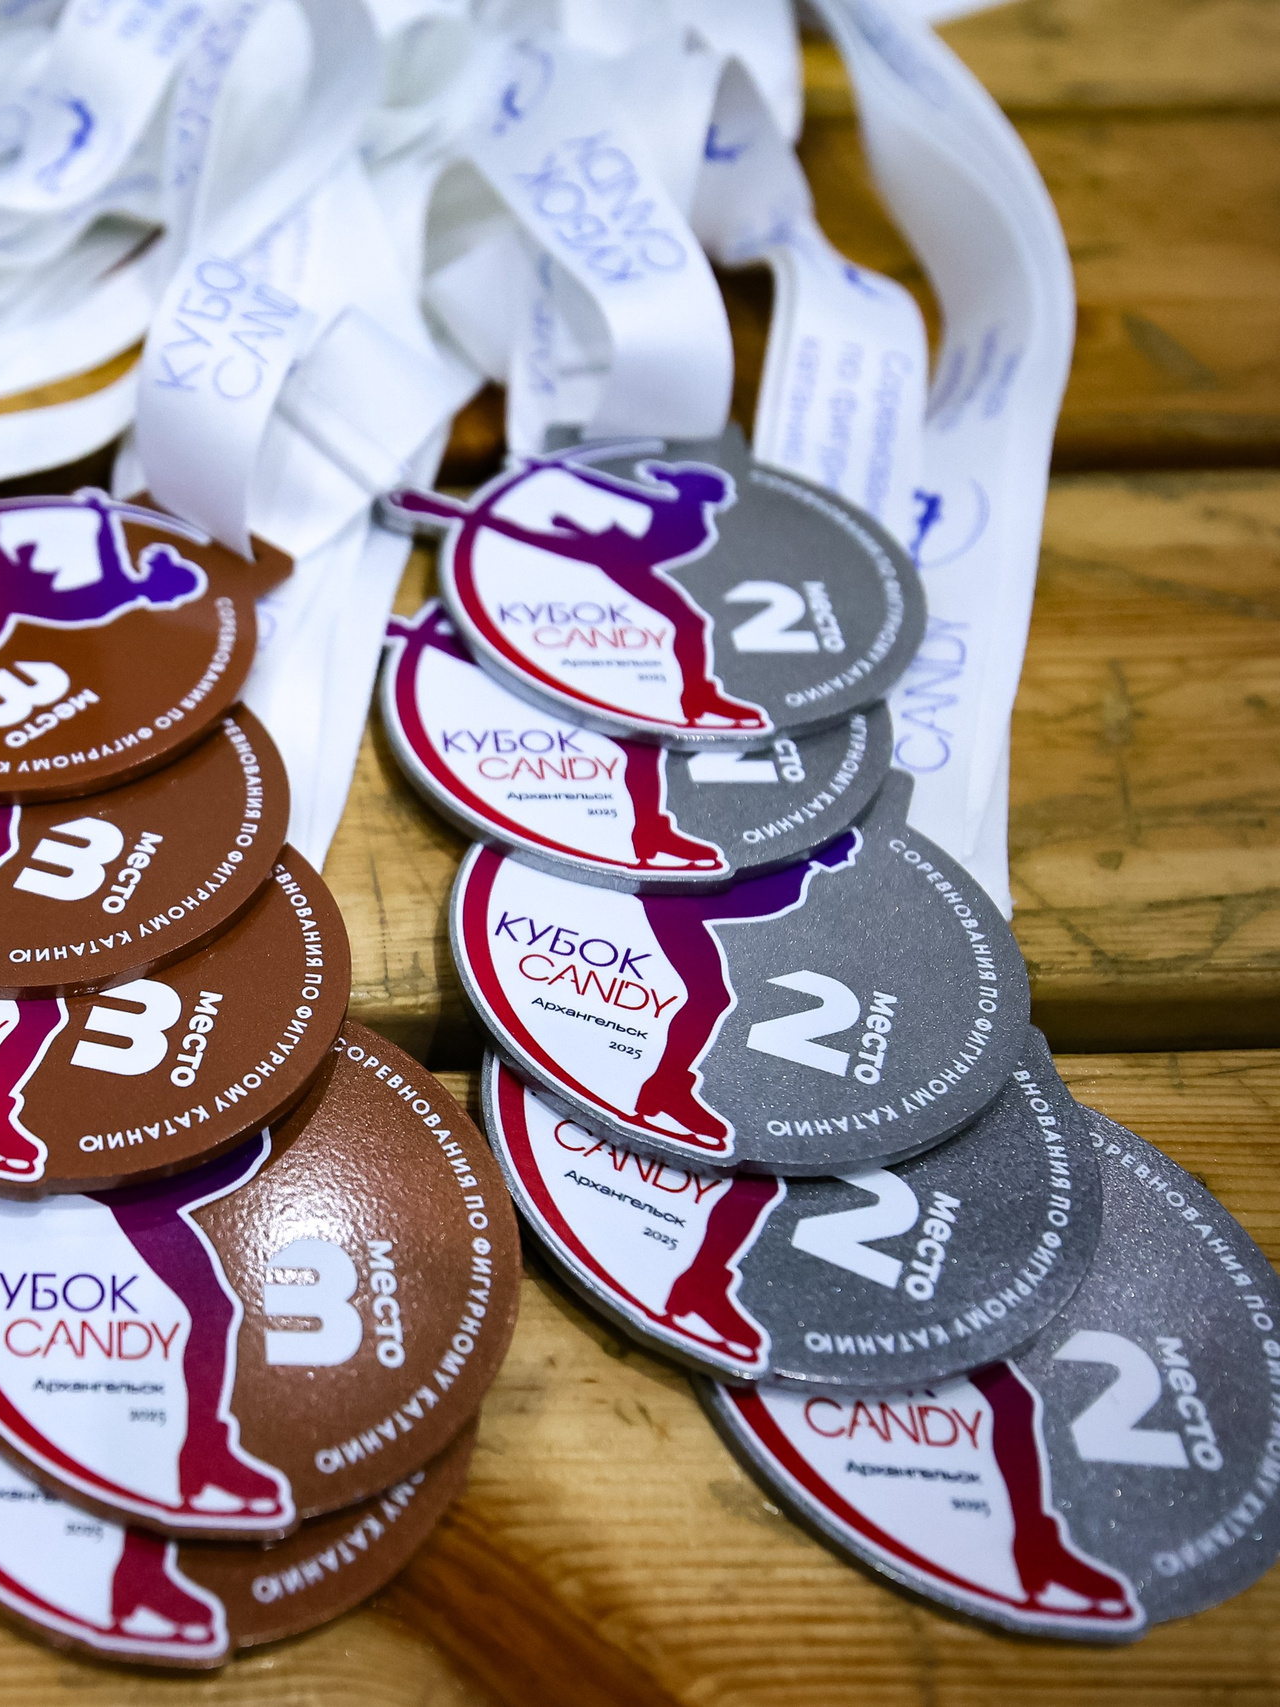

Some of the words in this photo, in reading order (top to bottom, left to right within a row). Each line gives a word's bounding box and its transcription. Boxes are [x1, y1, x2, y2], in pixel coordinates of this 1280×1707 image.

[153, 258, 247, 394] КУБО
[497, 601, 632, 626] КУБОК
[534, 626, 667, 651] CANDY
[724, 579, 820, 654] 2
[4, 688, 101, 748] Место
[18, 725, 153, 773] ФИГУРНОМУ
[154, 708, 185, 729] ПО
[442, 728, 584, 754] КУБОК
[223, 717, 263, 820] РЕВНОВАНИЯ
[477, 756, 619, 781] CANDY
[506, 789, 614, 802] Архангельск
[235, 822, 260, 848] ПО
[743, 793, 834, 845] КАТАНИЮ
[13, 817, 124, 901] 3
[102, 831, 163, 914] Место
[140, 850, 241, 938] ФИГУРНОМУ
[888, 837, 998, 984] СОРЕВНОВАНИЯ
[9, 930, 133, 963] КАТАНИЮ
[494, 911, 653, 980] КУБОК
[300, 972, 324, 1003] ПО
[519, 953, 679, 1020] CANDY
[531, 996, 648, 1040] Архангельск
[976, 985, 999, 1014] ПО
[70, 978, 182, 1075] 3
[170, 990, 223, 1088] Место
[609, 1041, 643, 1060] 2025
[745, 969, 860, 1078] 2
[855, 990, 898, 1086] Место
[216, 1007, 313, 1111] ФИГУРНОМУ
[897, 1016, 994, 1121] ФИГУРНОМУ
[79, 1108, 211, 1152] КАТАНИЮ
[767, 1104, 900, 1137] КАТАНИЮ
[554, 1118, 725, 1205] CANDY
[463, 1194, 489, 1229] ПО
[564, 1167, 687, 1228] Архангельск
[790, 1166, 920, 1289] 2
[1044, 1194, 1071, 1228] ПО
[1089, 1131, 1252, 1288] ОРЕВНОВАНИЯ
[642, 1226, 679, 1251] 2025
[904, 1190, 962, 1301] Место
[264, 1238, 365, 1368] 3
[368, 1238, 407, 1369] Место
[436, 1237, 492, 1390] ФИГУРНОМУ
[958, 1229, 1065, 1345] ФИГУРНОМУ
[1242, 1294, 1275, 1331] ПО
[4, 1318, 181, 1360] CANDY
[805, 1323, 957, 1354] КАТАНИЮ
[316, 1388, 438, 1475] КАТАНИЮ
[804, 1397, 983, 1450] CANDY
[1052, 1328, 1190, 1470] 2
[1155, 1336, 1223, 1472] Место
[251, 1523, 386, 1606] КАТАНИЮ
[1152, 1491, 1267, 1578] КАТАНИЮ
